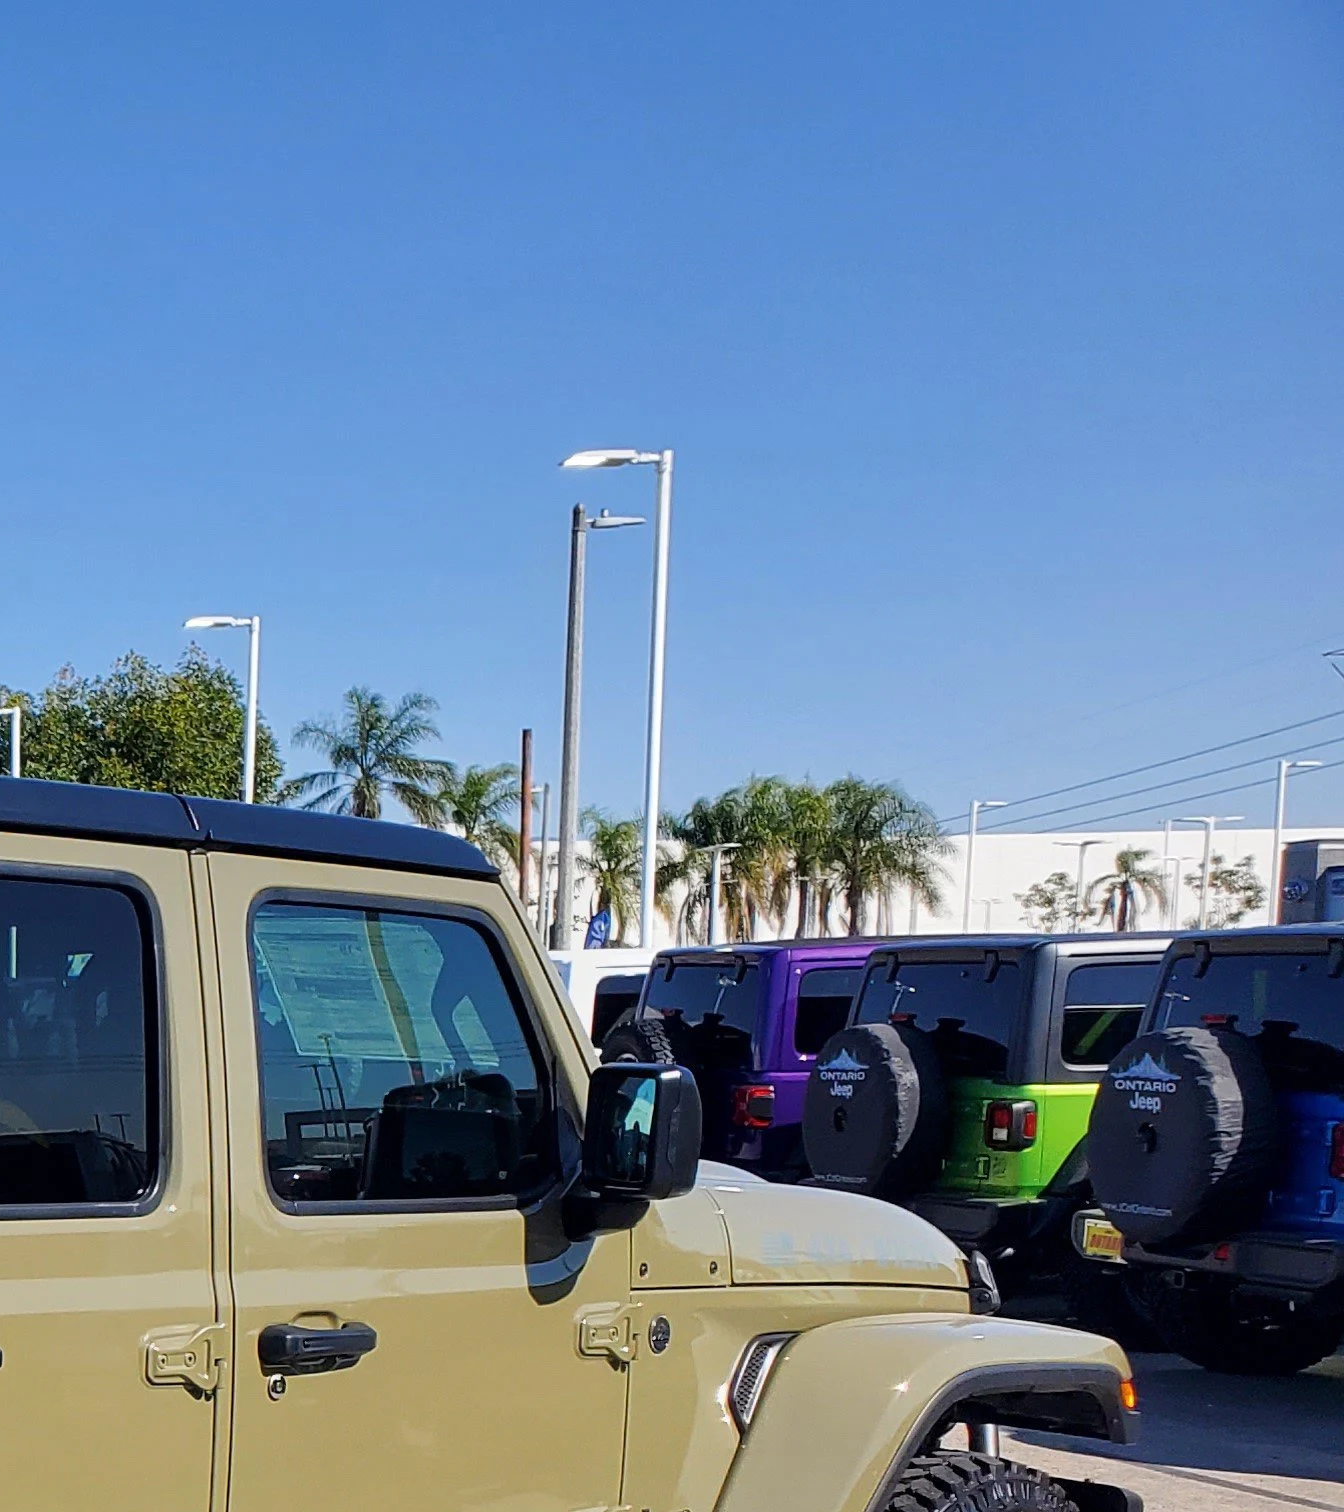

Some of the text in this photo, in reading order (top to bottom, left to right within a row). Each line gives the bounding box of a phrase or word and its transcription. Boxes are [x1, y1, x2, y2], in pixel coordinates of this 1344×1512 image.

[819, 1071, 866, 1081] ONTARIO
[830, 1081, 853, 1099] Jeep
[1114, 1079, 1177, 1093] ONTARIO
[1129, 1091, 1162, 1114] Jeep
